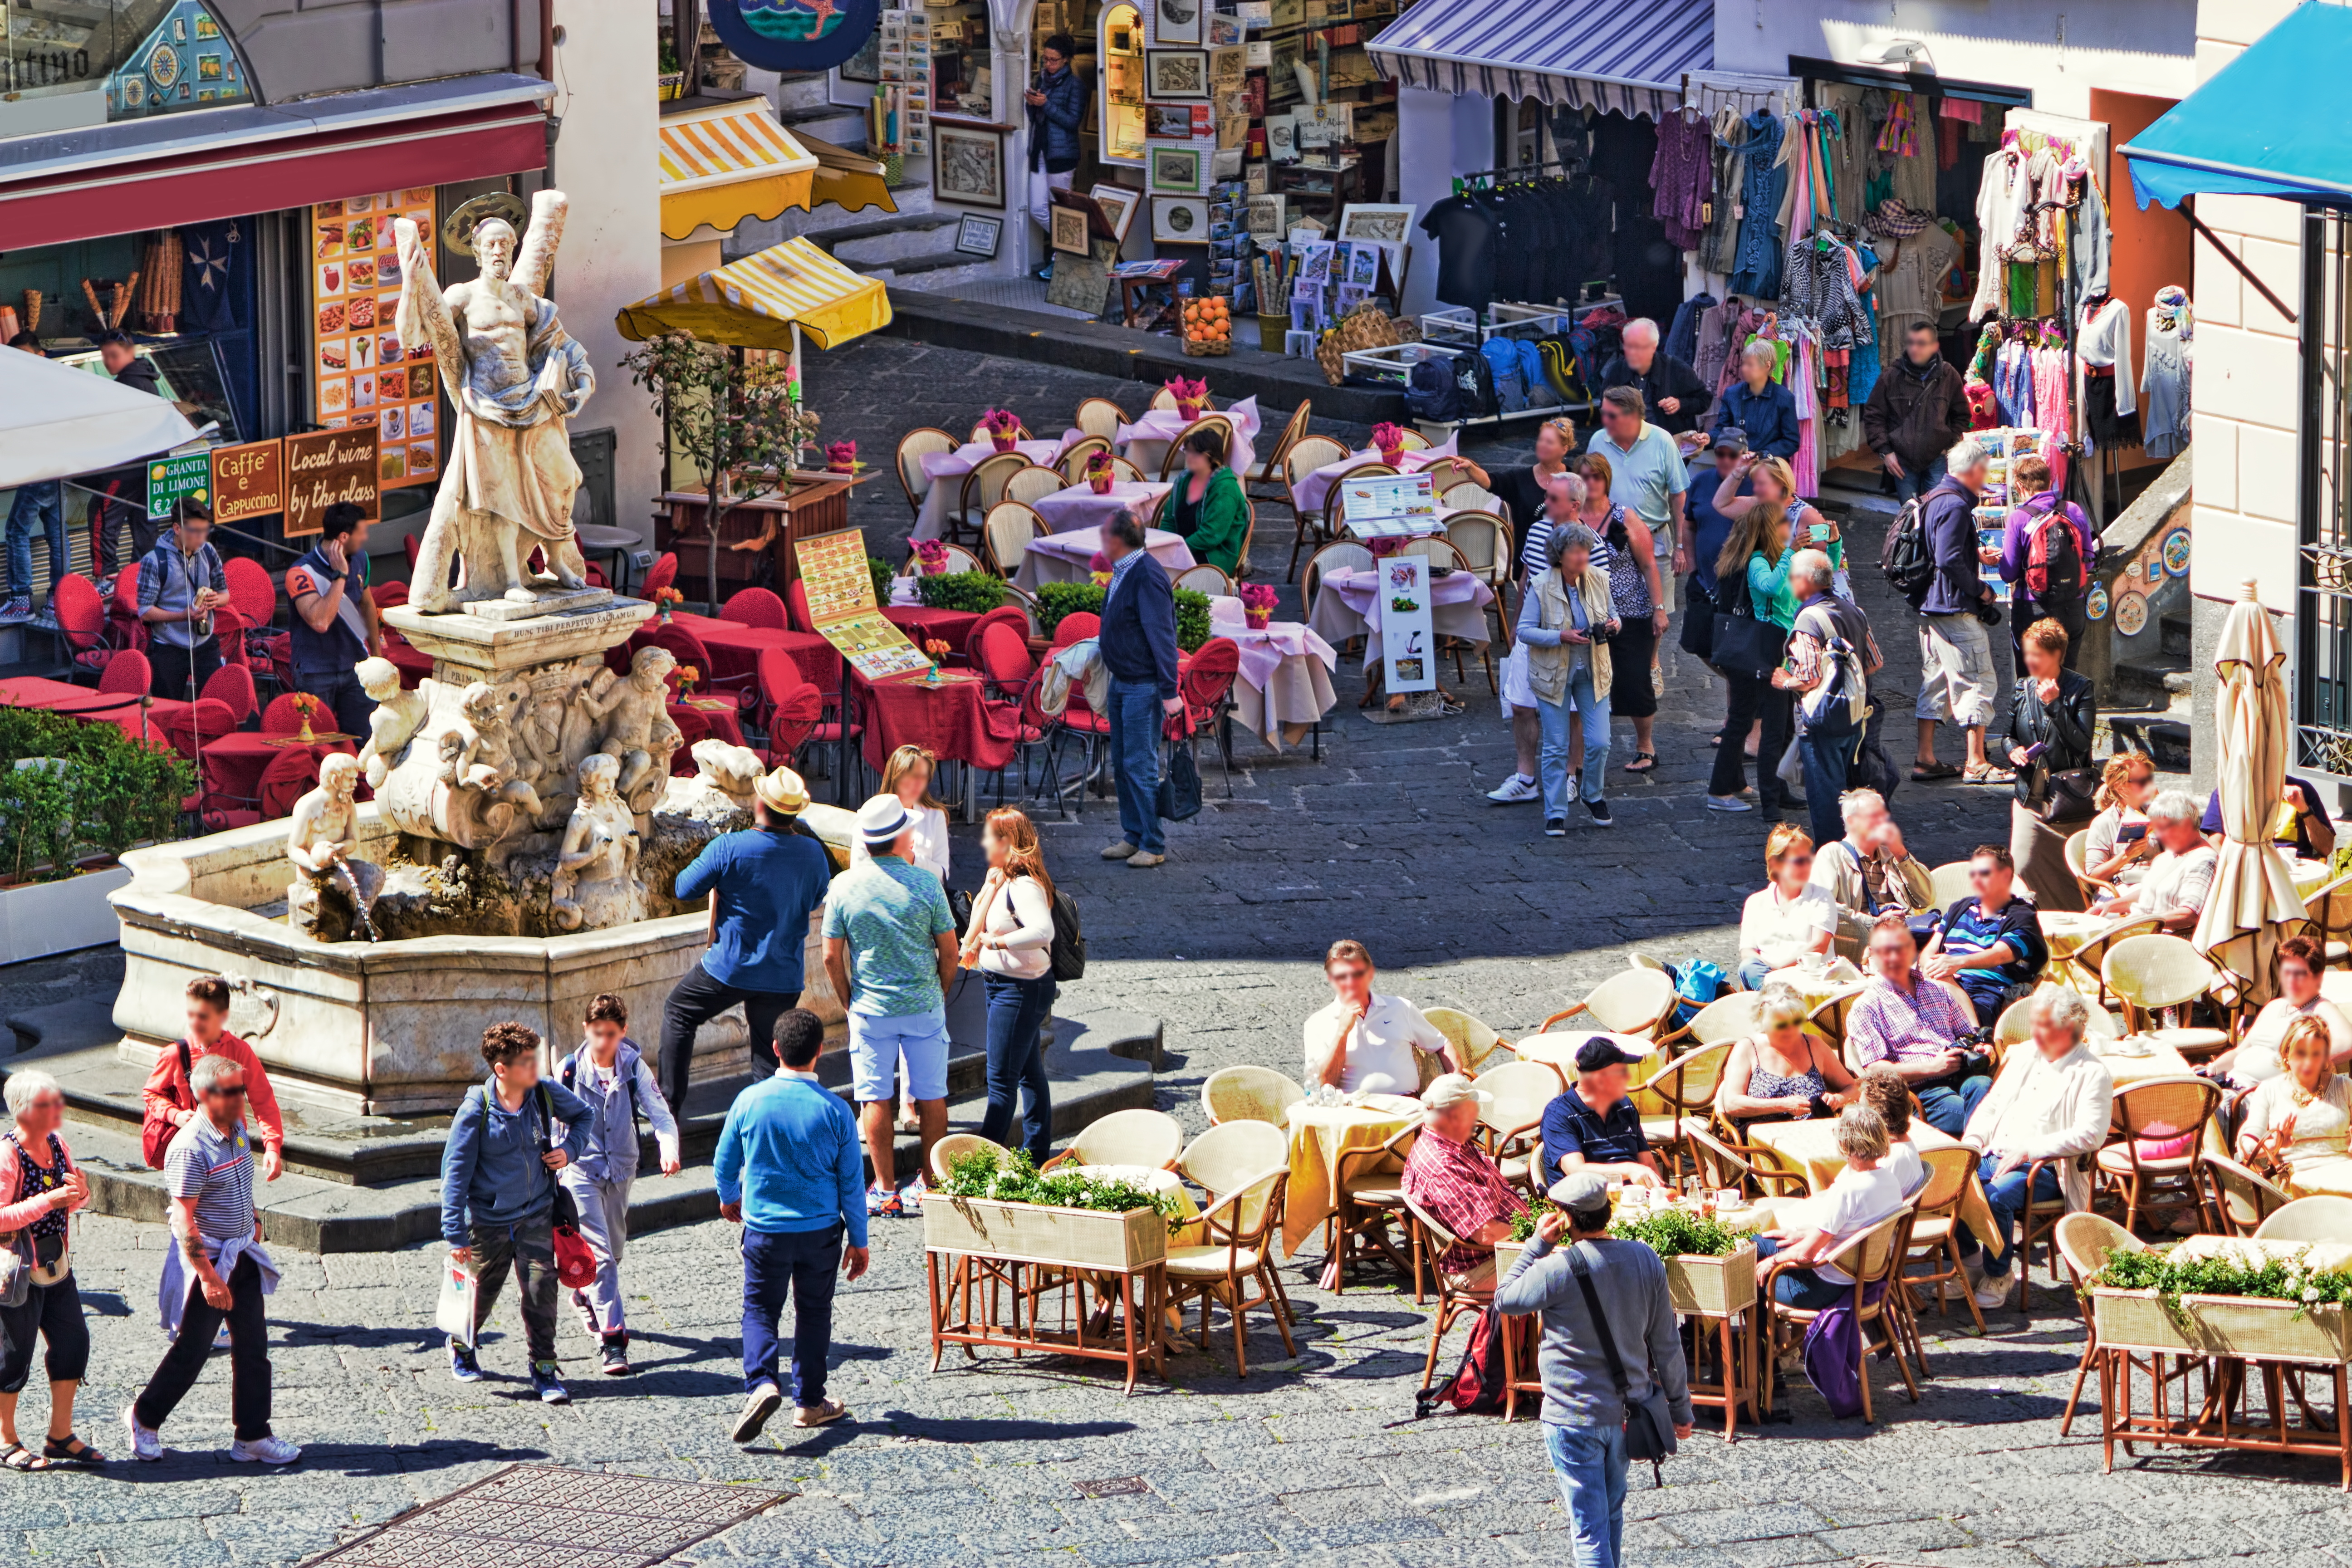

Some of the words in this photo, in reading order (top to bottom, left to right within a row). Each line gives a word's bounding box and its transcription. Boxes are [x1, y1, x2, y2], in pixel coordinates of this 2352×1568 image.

[292, 439, 336, 472] Local
[338, 437, 372, 464] wine
[166, 459, 207, 476] GRANITA
[153, 482, 164, 494] DI
[169, 475, 206, 492] LIMONE
[238, 477, 248, 490] e
[217, 491, 277, 517] Cappuccino
[290, 484, 309, 524] by
[312, 479, 336, 509] the
[295, 574, 309, 591] 2
[514, 628, 534, 637] HUNC
[536, 624, 553, 633] TIBI
[556, 617, 594, 630] PERPETUO
[597, 610, 636, 623] SACRAMUS
[451, 671, 478, 683] PRIMA
